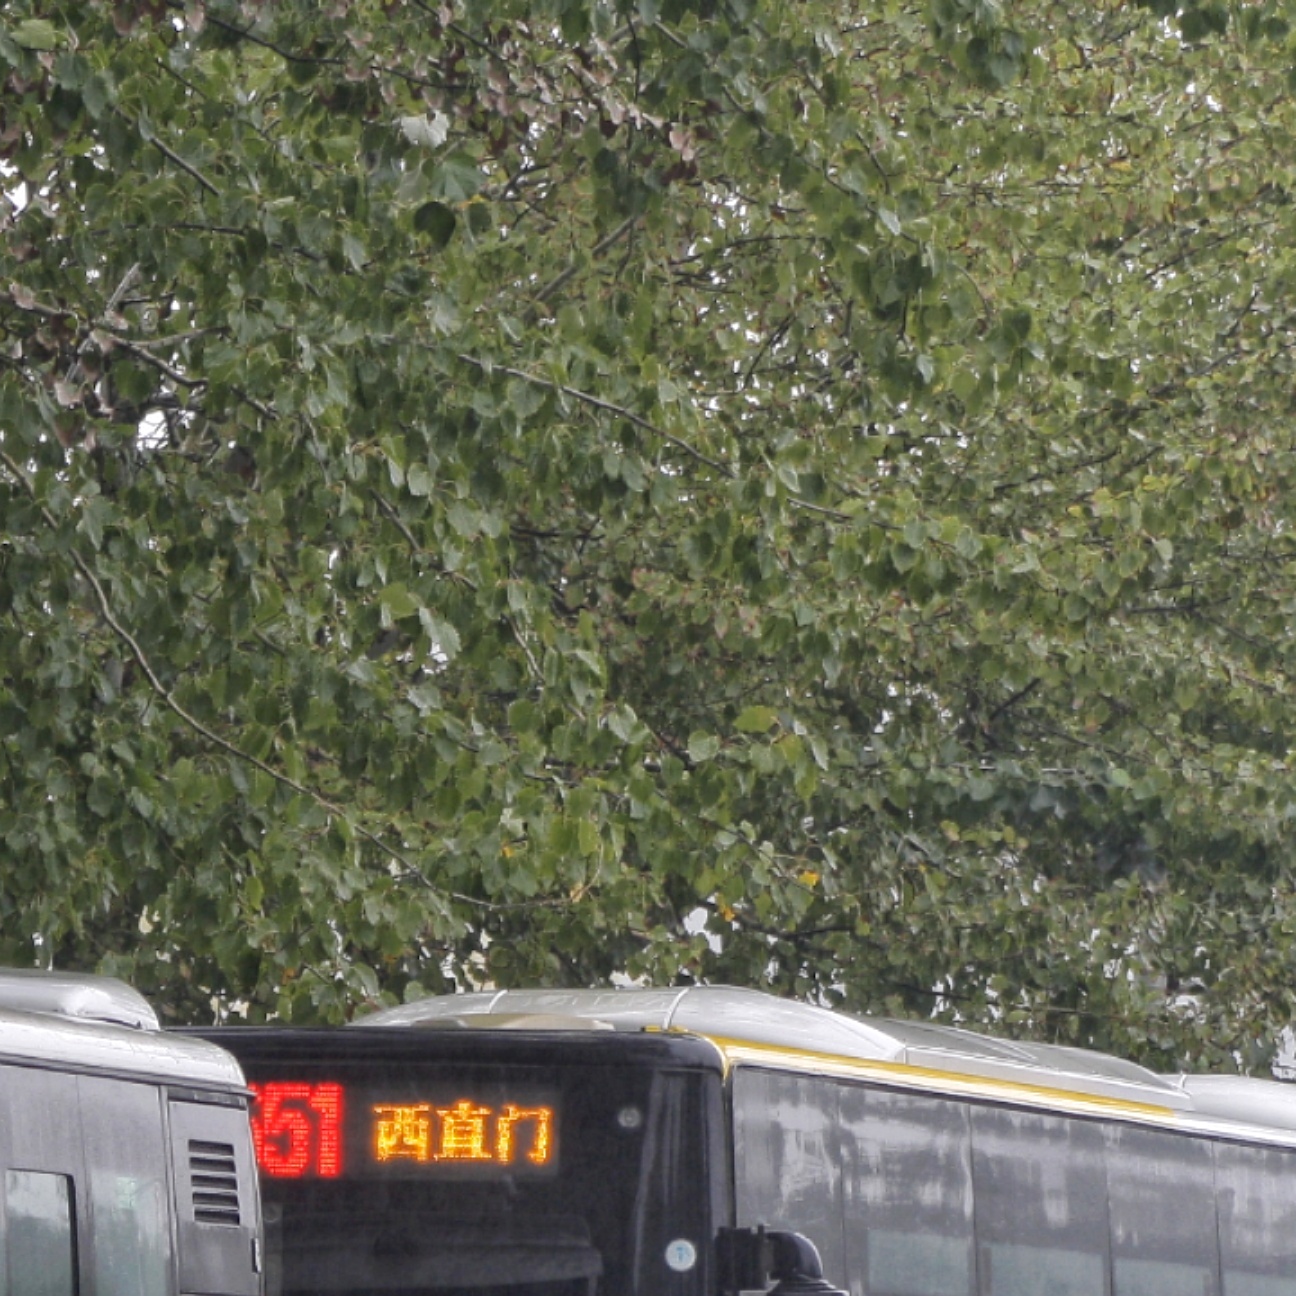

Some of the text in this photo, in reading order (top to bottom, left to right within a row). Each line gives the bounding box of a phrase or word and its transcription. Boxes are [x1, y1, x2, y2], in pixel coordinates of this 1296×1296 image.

[249, 1082, 552, 1178] 51 西直门
